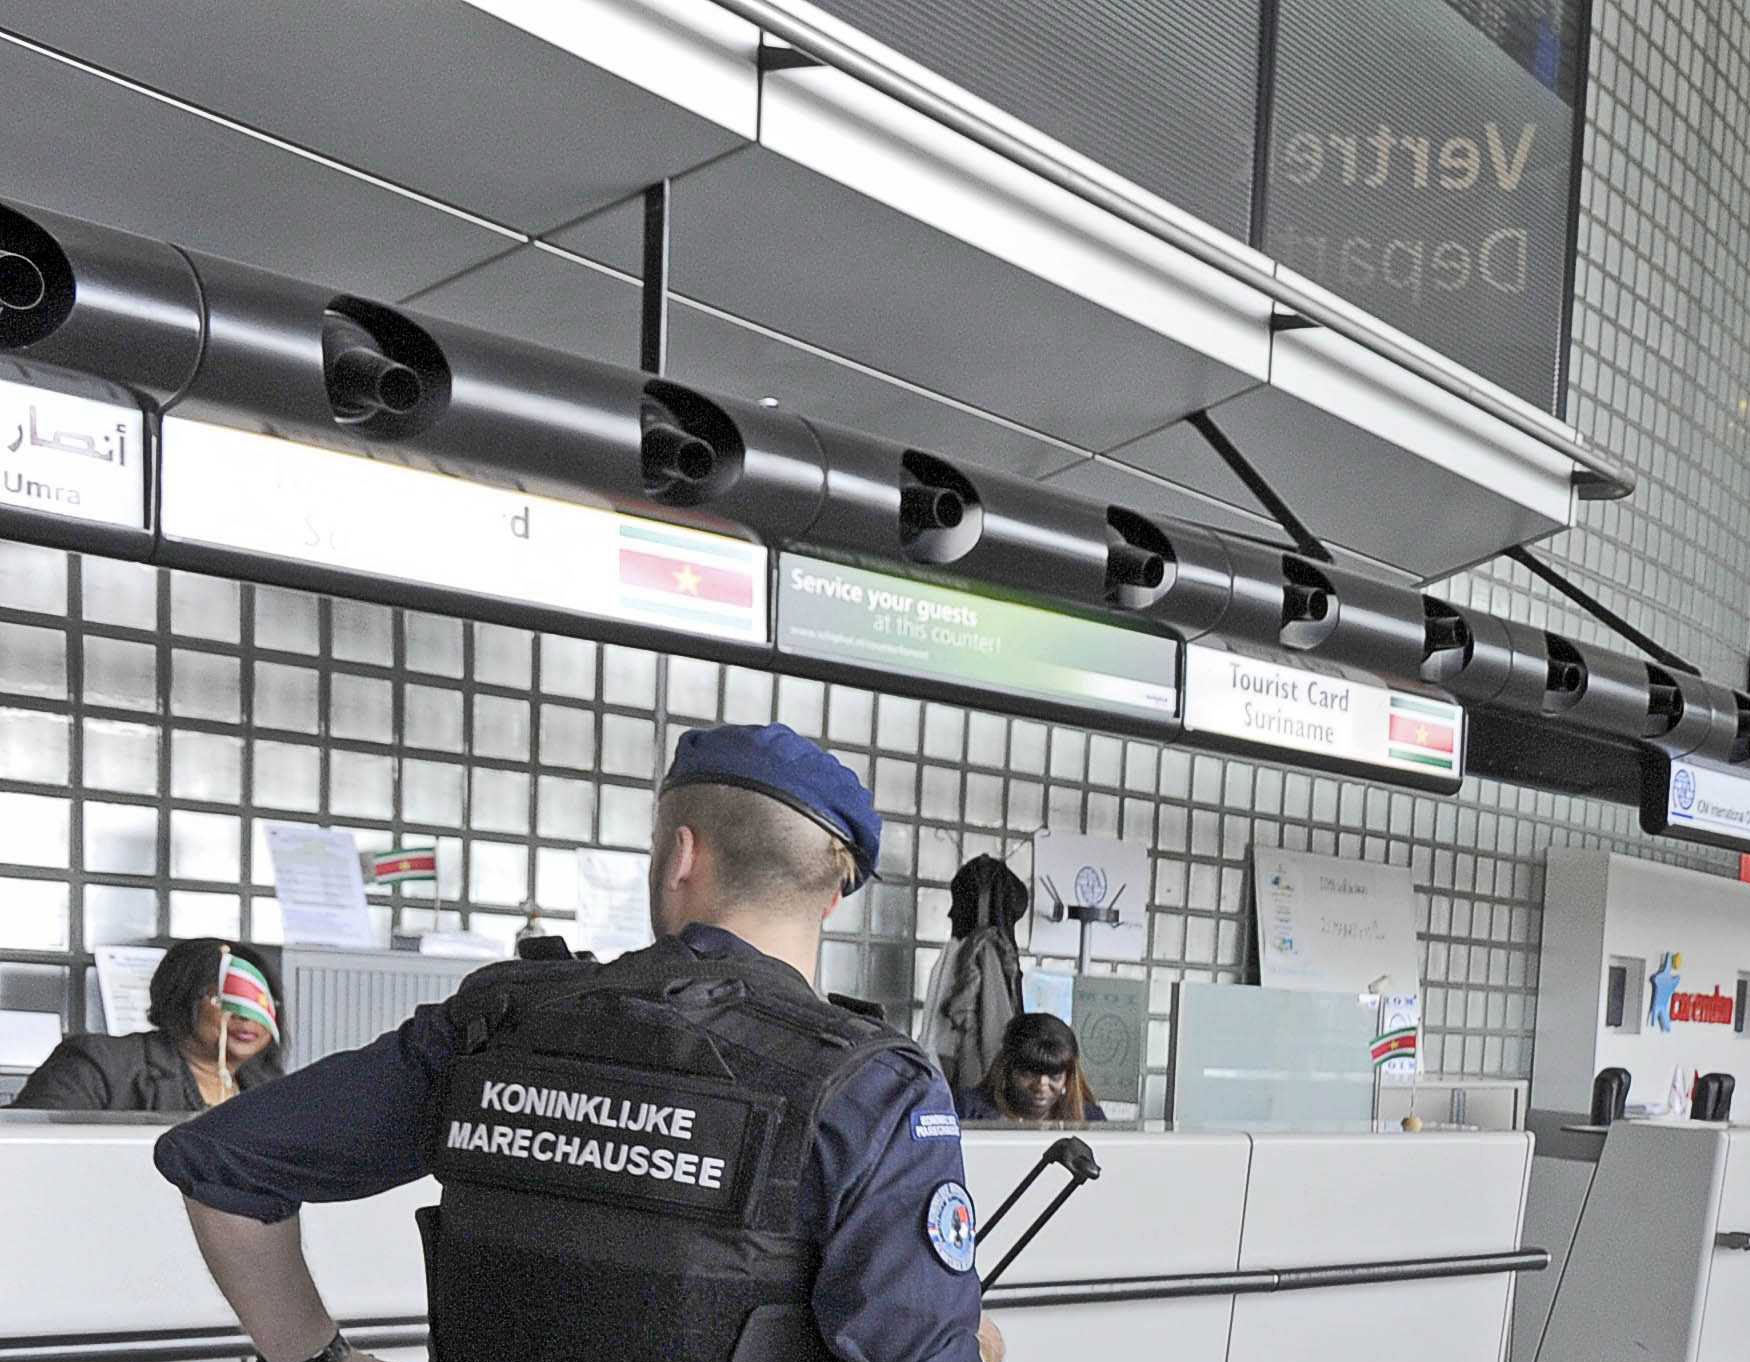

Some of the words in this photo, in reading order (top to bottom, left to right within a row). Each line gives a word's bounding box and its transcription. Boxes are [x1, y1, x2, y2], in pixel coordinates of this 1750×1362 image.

[4, 470, 82, 505] Umra
[791, 567, 863, 603] Service
[867, 588, 914, 612] your
[917, 600, 979, 627] guests
[872, 613, 894, 634] at
[897, 616, 927, 642] this
[1229, 662, 1299, 702] Tourist
[1307, 680, 1350, 713] Card
[1243, 702, 1335, 745] Suriname
[1670, 983, 1734, 1025] corendon
[481, 1080, 696, 1141] KONINKLIJKE
[447, 1120, 725, 1190] MARECHAUSSEE
